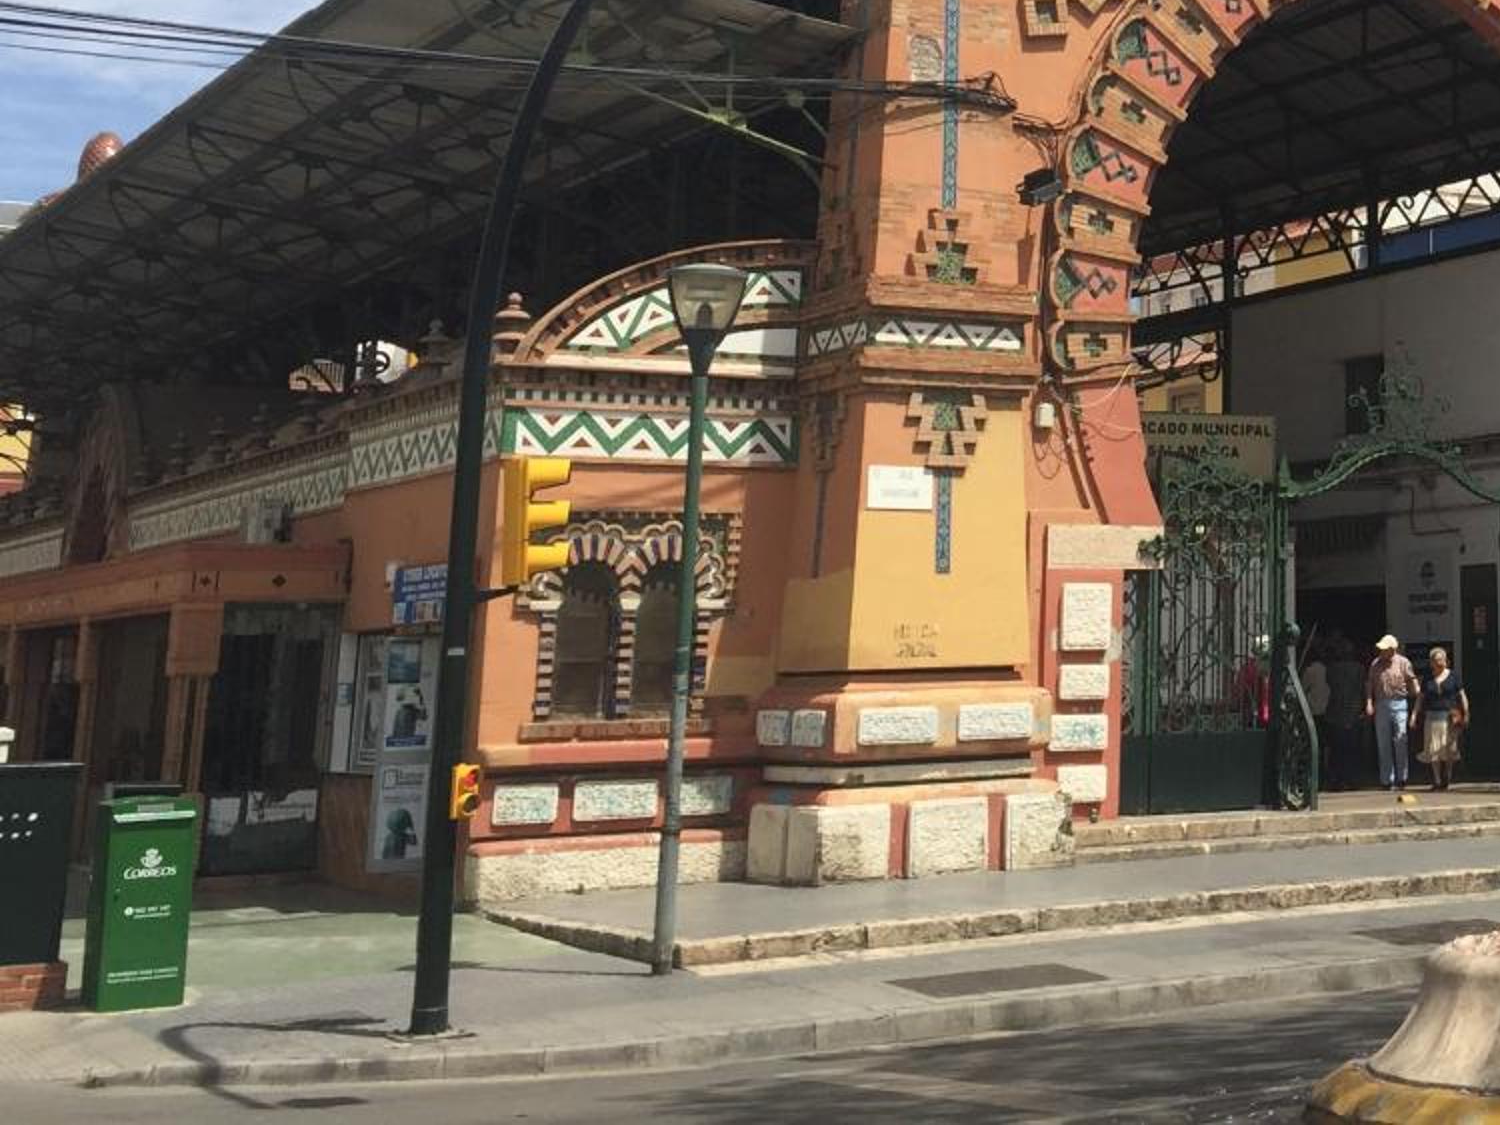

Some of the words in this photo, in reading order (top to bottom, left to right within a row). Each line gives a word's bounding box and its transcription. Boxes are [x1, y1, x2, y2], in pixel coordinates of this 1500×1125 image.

[1192, 422, 1272, 438] MUNICIPAL
[1147, 444, 1240, 459] SALAMACA
[123, 865, 177, 880] CORREOS
